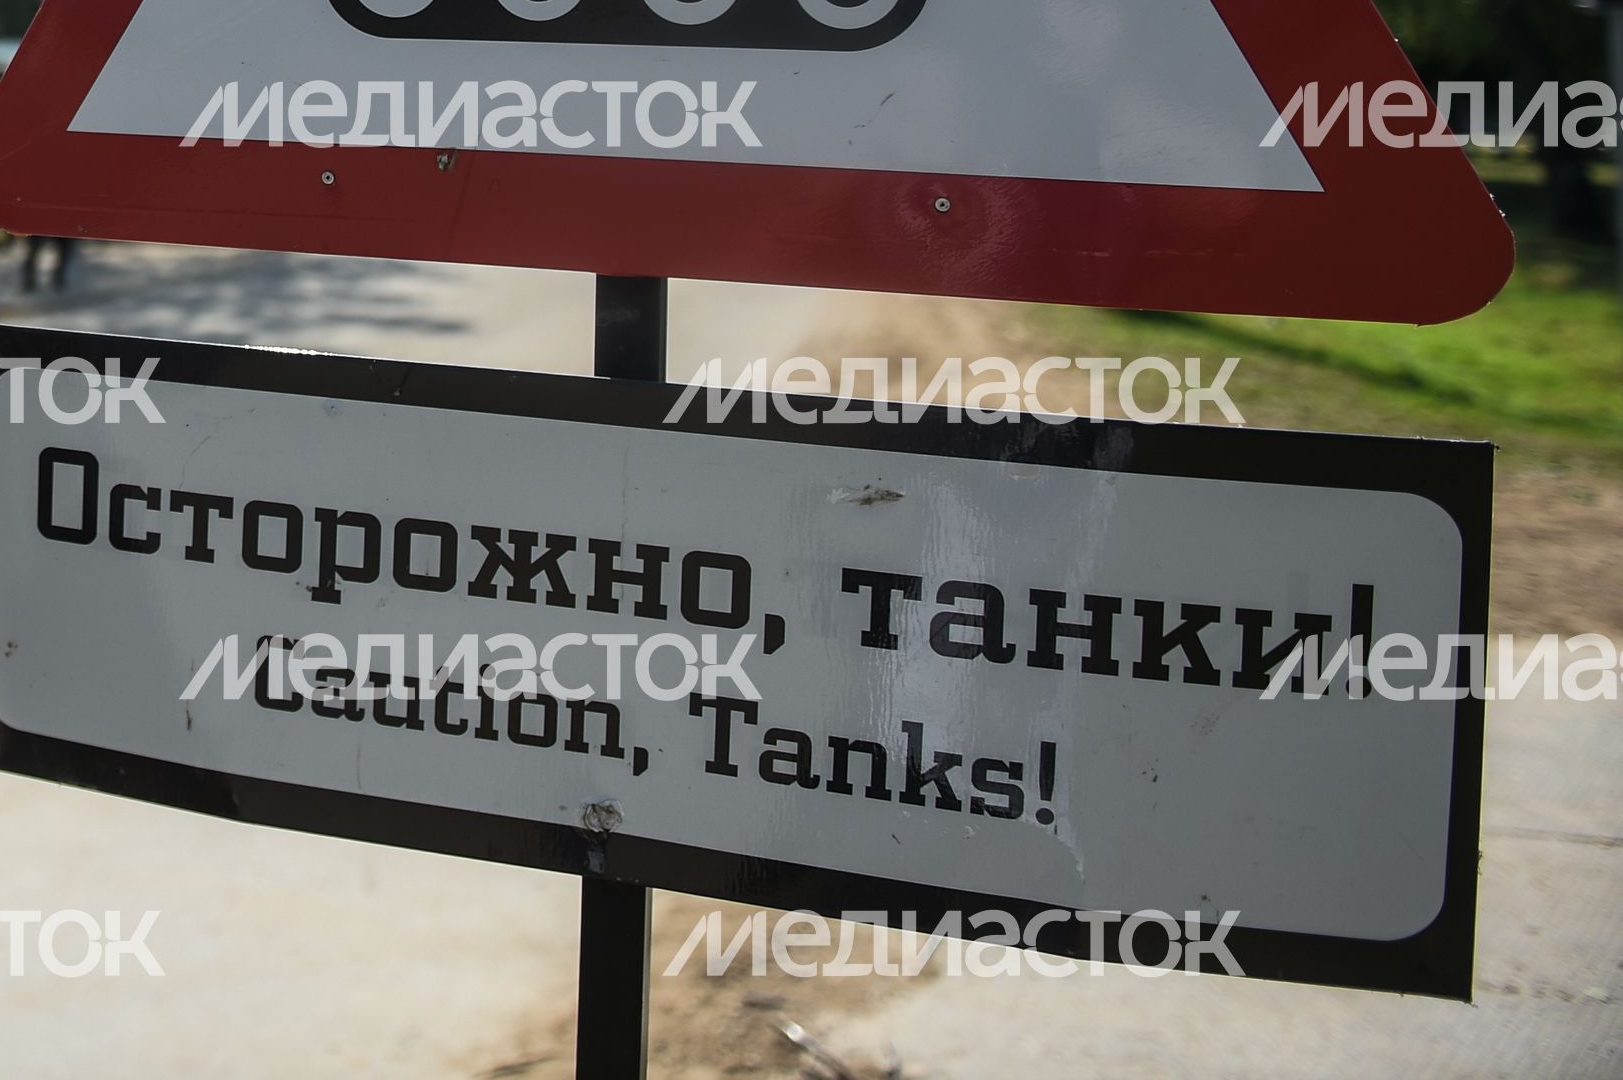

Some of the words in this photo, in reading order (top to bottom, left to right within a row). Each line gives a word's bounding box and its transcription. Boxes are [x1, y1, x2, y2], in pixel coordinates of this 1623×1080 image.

[37, 445, 787, 656] Осторожно,
[840, 566, 1375, 700] танки!
[254, 633, 649, 777] Caution,
[690, 690, 1057, 826] Tanks!
